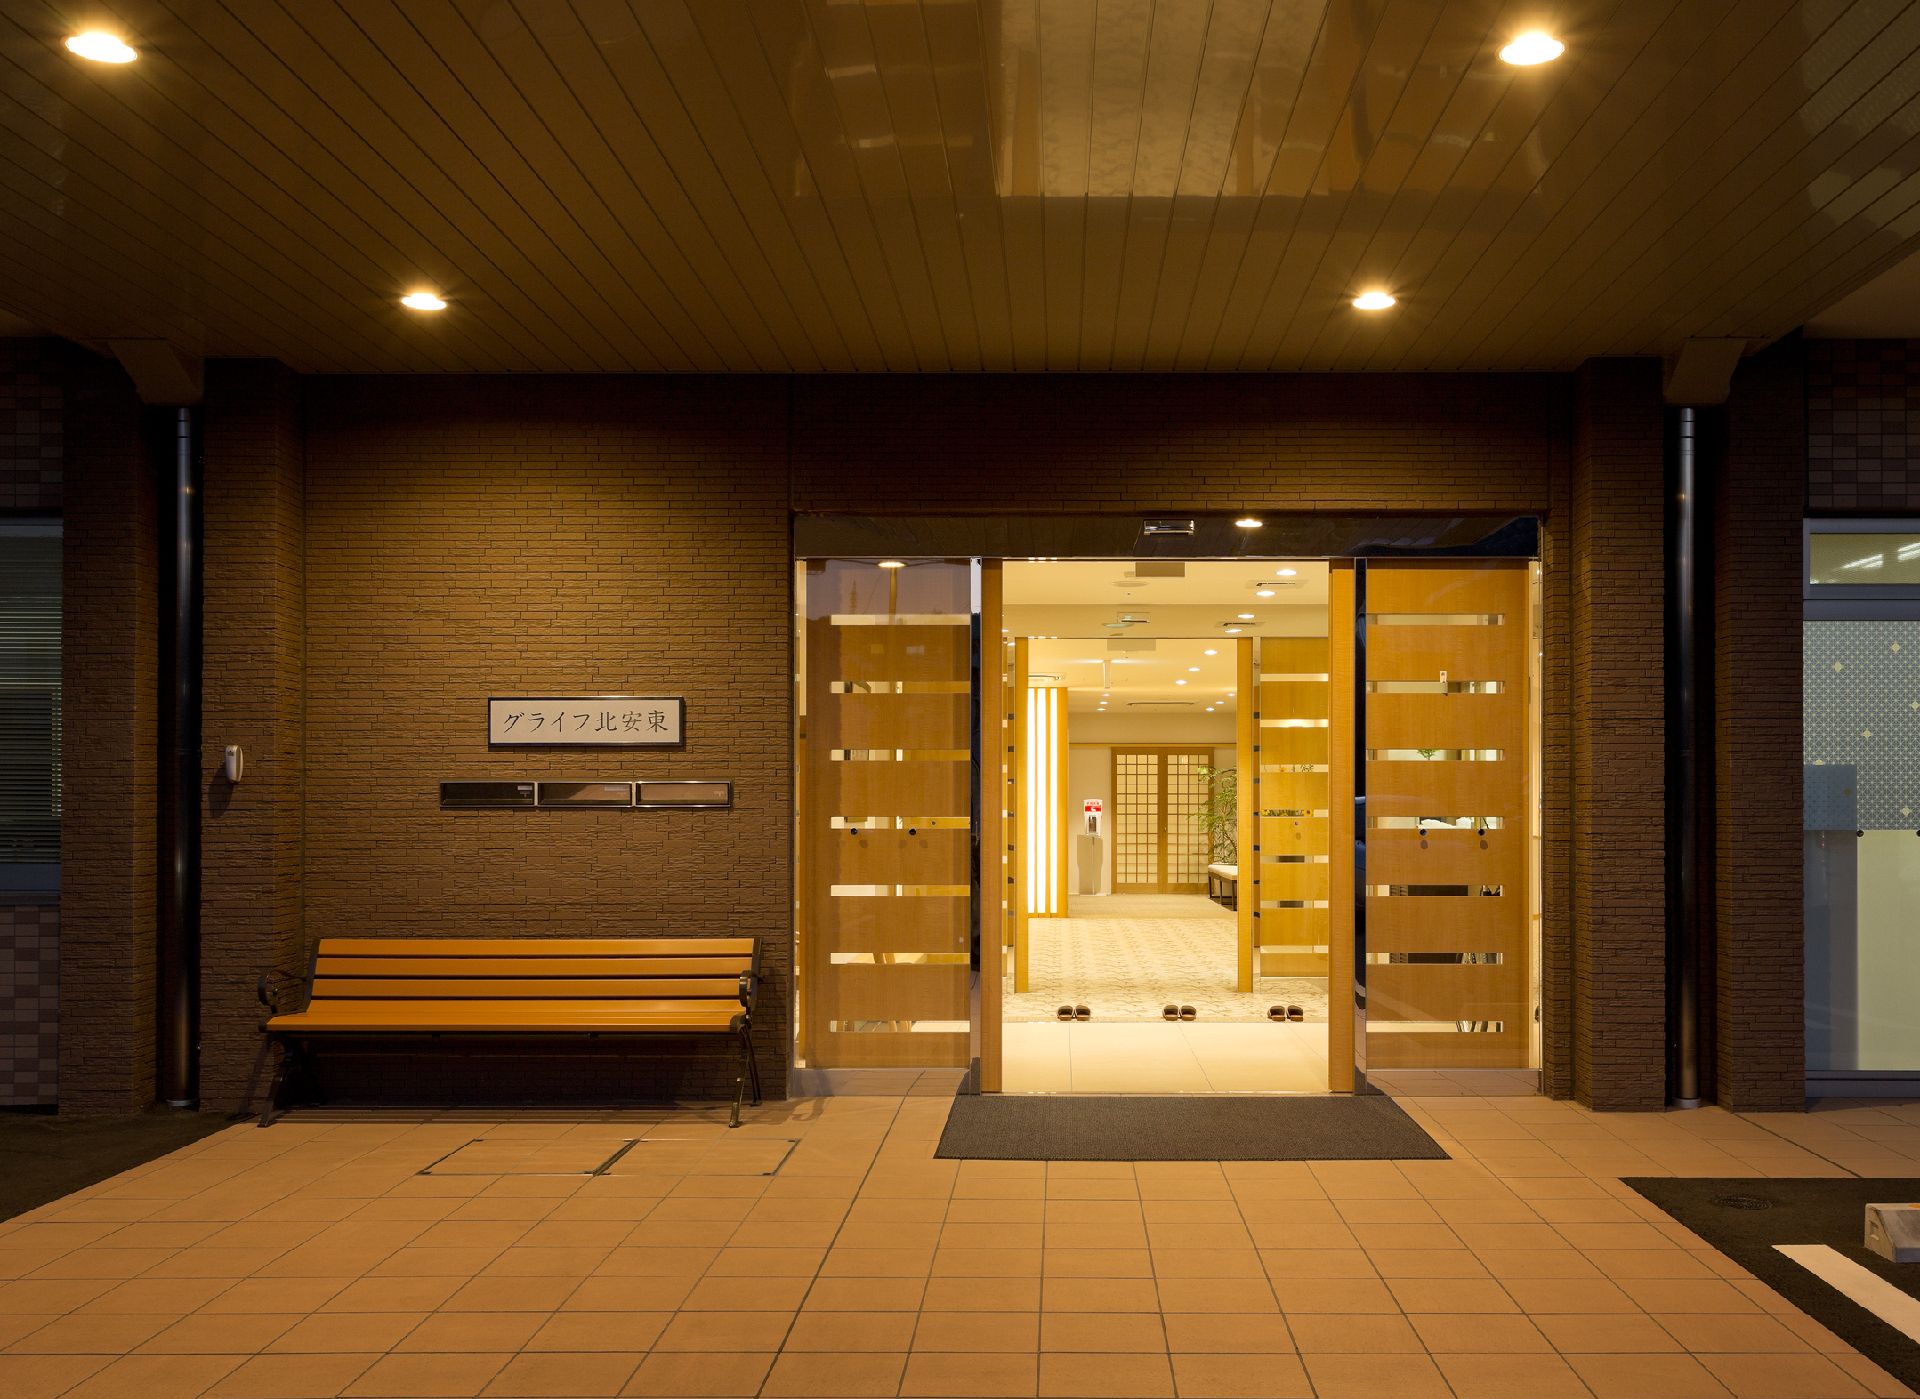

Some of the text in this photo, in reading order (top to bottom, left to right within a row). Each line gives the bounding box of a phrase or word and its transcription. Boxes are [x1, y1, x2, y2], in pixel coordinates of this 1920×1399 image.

[503, 710, 669, 733] グライフ北安東
